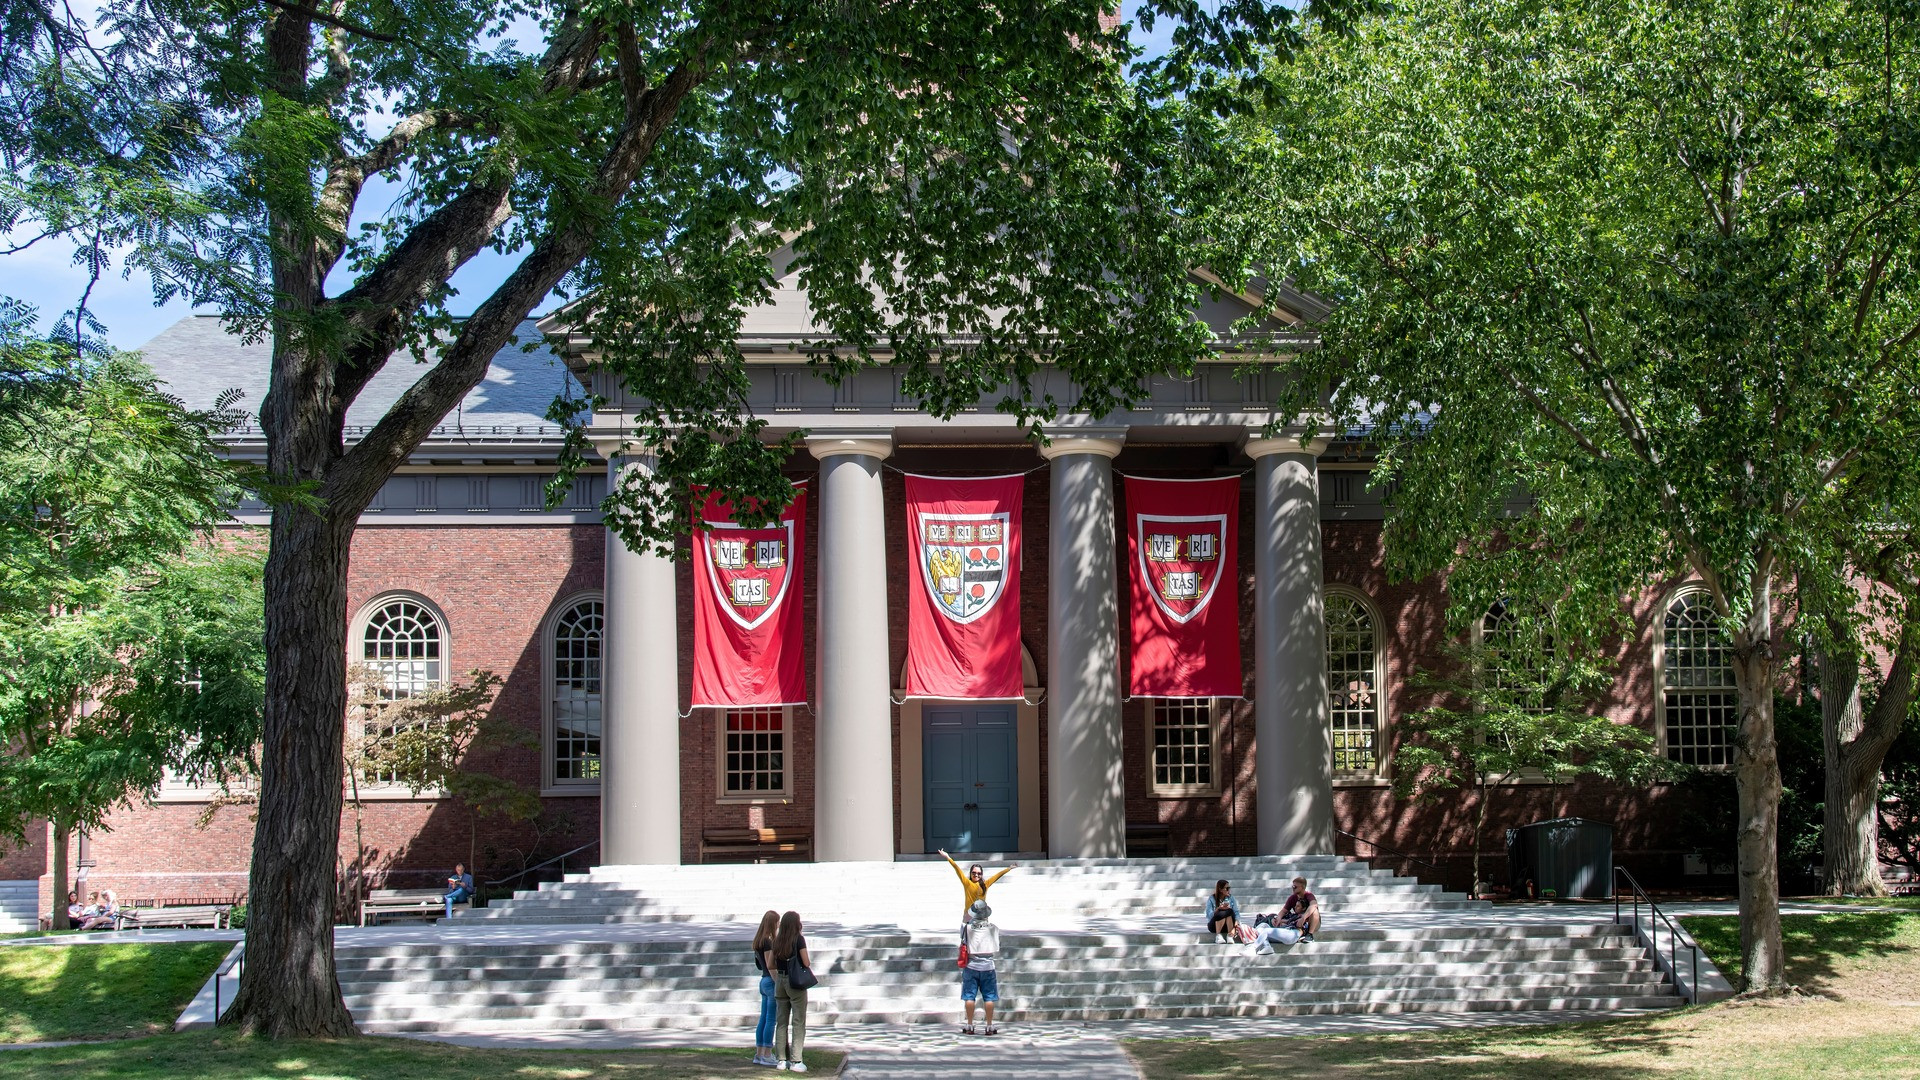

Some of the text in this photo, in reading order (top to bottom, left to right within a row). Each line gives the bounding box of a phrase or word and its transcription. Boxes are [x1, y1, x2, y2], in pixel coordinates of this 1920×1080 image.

[932, 526, 996, 536] VE RI TAS
[1154, 541, 1208, 553] VE RI
[721, 547, 776, 560] VE RI
[1171, 578, 1194, 590] TAS
[739, 585, 761, 596] TAS
